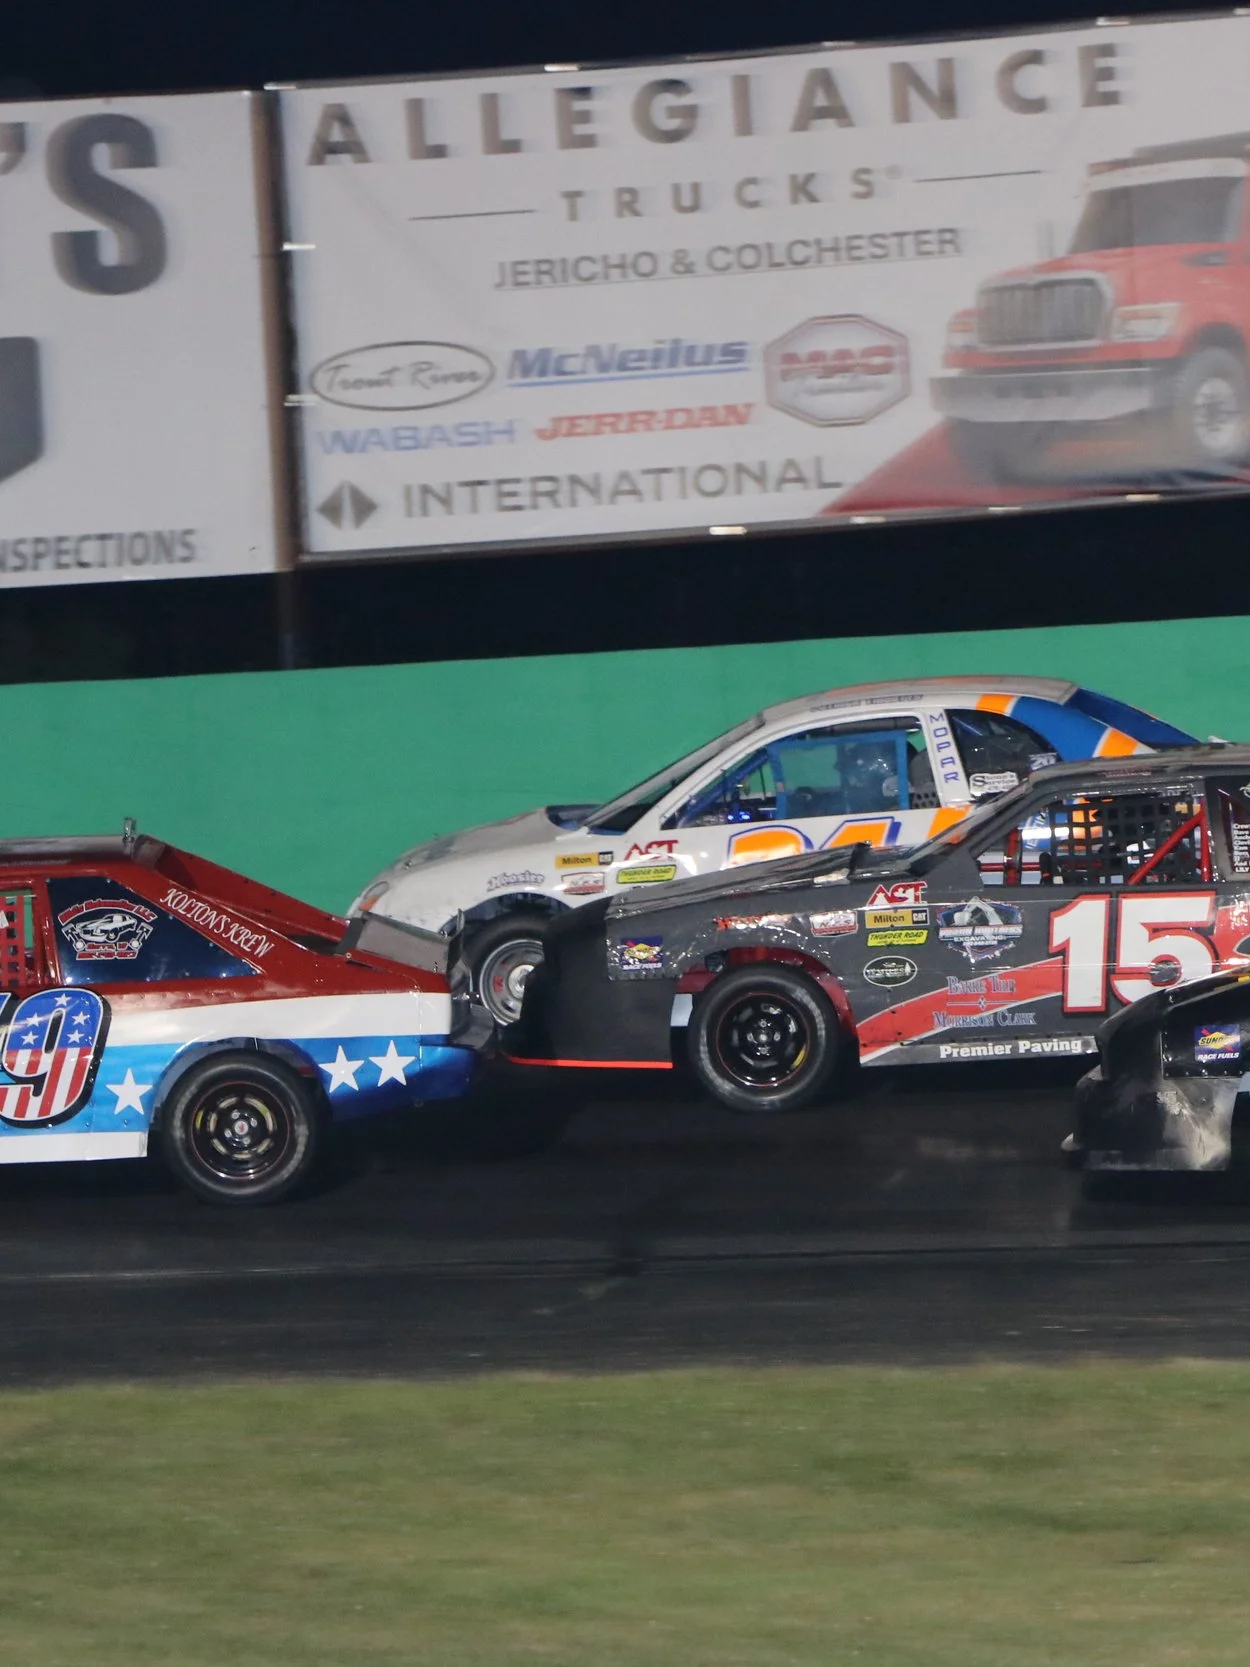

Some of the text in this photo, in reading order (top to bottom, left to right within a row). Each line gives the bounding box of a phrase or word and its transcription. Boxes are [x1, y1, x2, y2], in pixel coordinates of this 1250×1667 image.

[307, 42, 1122, 166] ALLEGIANCE
[560, 168, 876, 222] TRUCKS
[495, 227, 962, 289] JERICHO & COLCHESTER
[507, 337, 749, 380] McNeilus
[316, 420, 517, 455] WABASH
[534, 403, 757, 441] JERR-DAN
[402, 457, 844, 518] INTERNATIONAL
[929, 712, 960, 783] MOPAR
[562, 855, 592, 865] Milton
[867, 881, 928, 906] ACT
[873, 914, 905, 923] Milton
[912, 912, 928, 922] CAT
[221, 922, 276, 958] KREW
[869, 932, 902, 941] THUNDER
[1049, 890, 1220, 1014] 15
[997, 1009, 1037, 1027] CLARK
[940, 1039, 1082, 1058] Premier Paving
[1198, 1051, 1240, 1060] RACE FUELS
